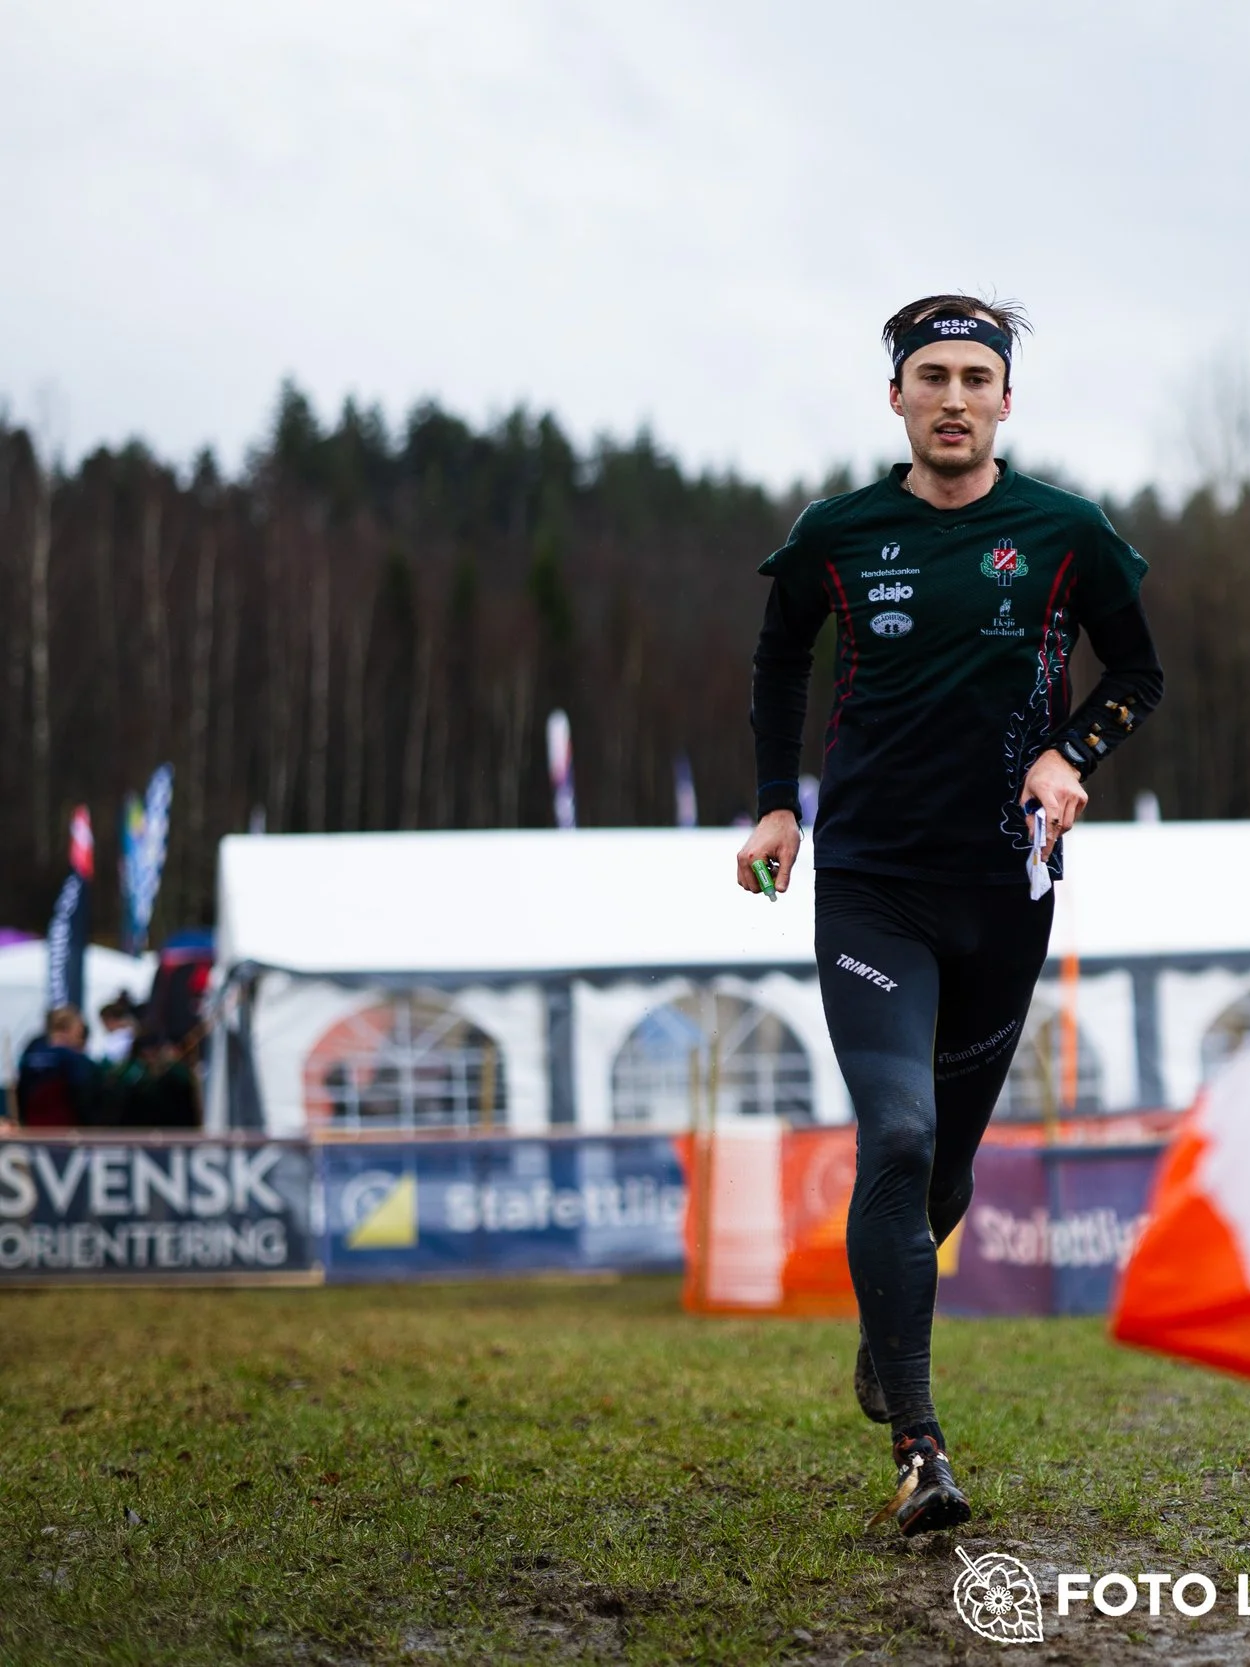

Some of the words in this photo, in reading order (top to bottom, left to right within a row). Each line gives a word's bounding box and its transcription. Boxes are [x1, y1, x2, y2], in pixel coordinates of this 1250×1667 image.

[933, 319, 977, 329] EKSJÖ
[941, 327, 970, 335] SOK
[861, 568, 920, 578] Handelsbanken
[868, 582, 913, 602] elajo
[993, 618, 1015, 628] Eksjö
[836, 954, 898, 992] TRIMTEX
[938, 1018, 1017, 1065] #TeamEksjöhus
[0, 1144, 287, 1218] SVENSK
[0, 1219, 289, 1269] ORIENTERING
